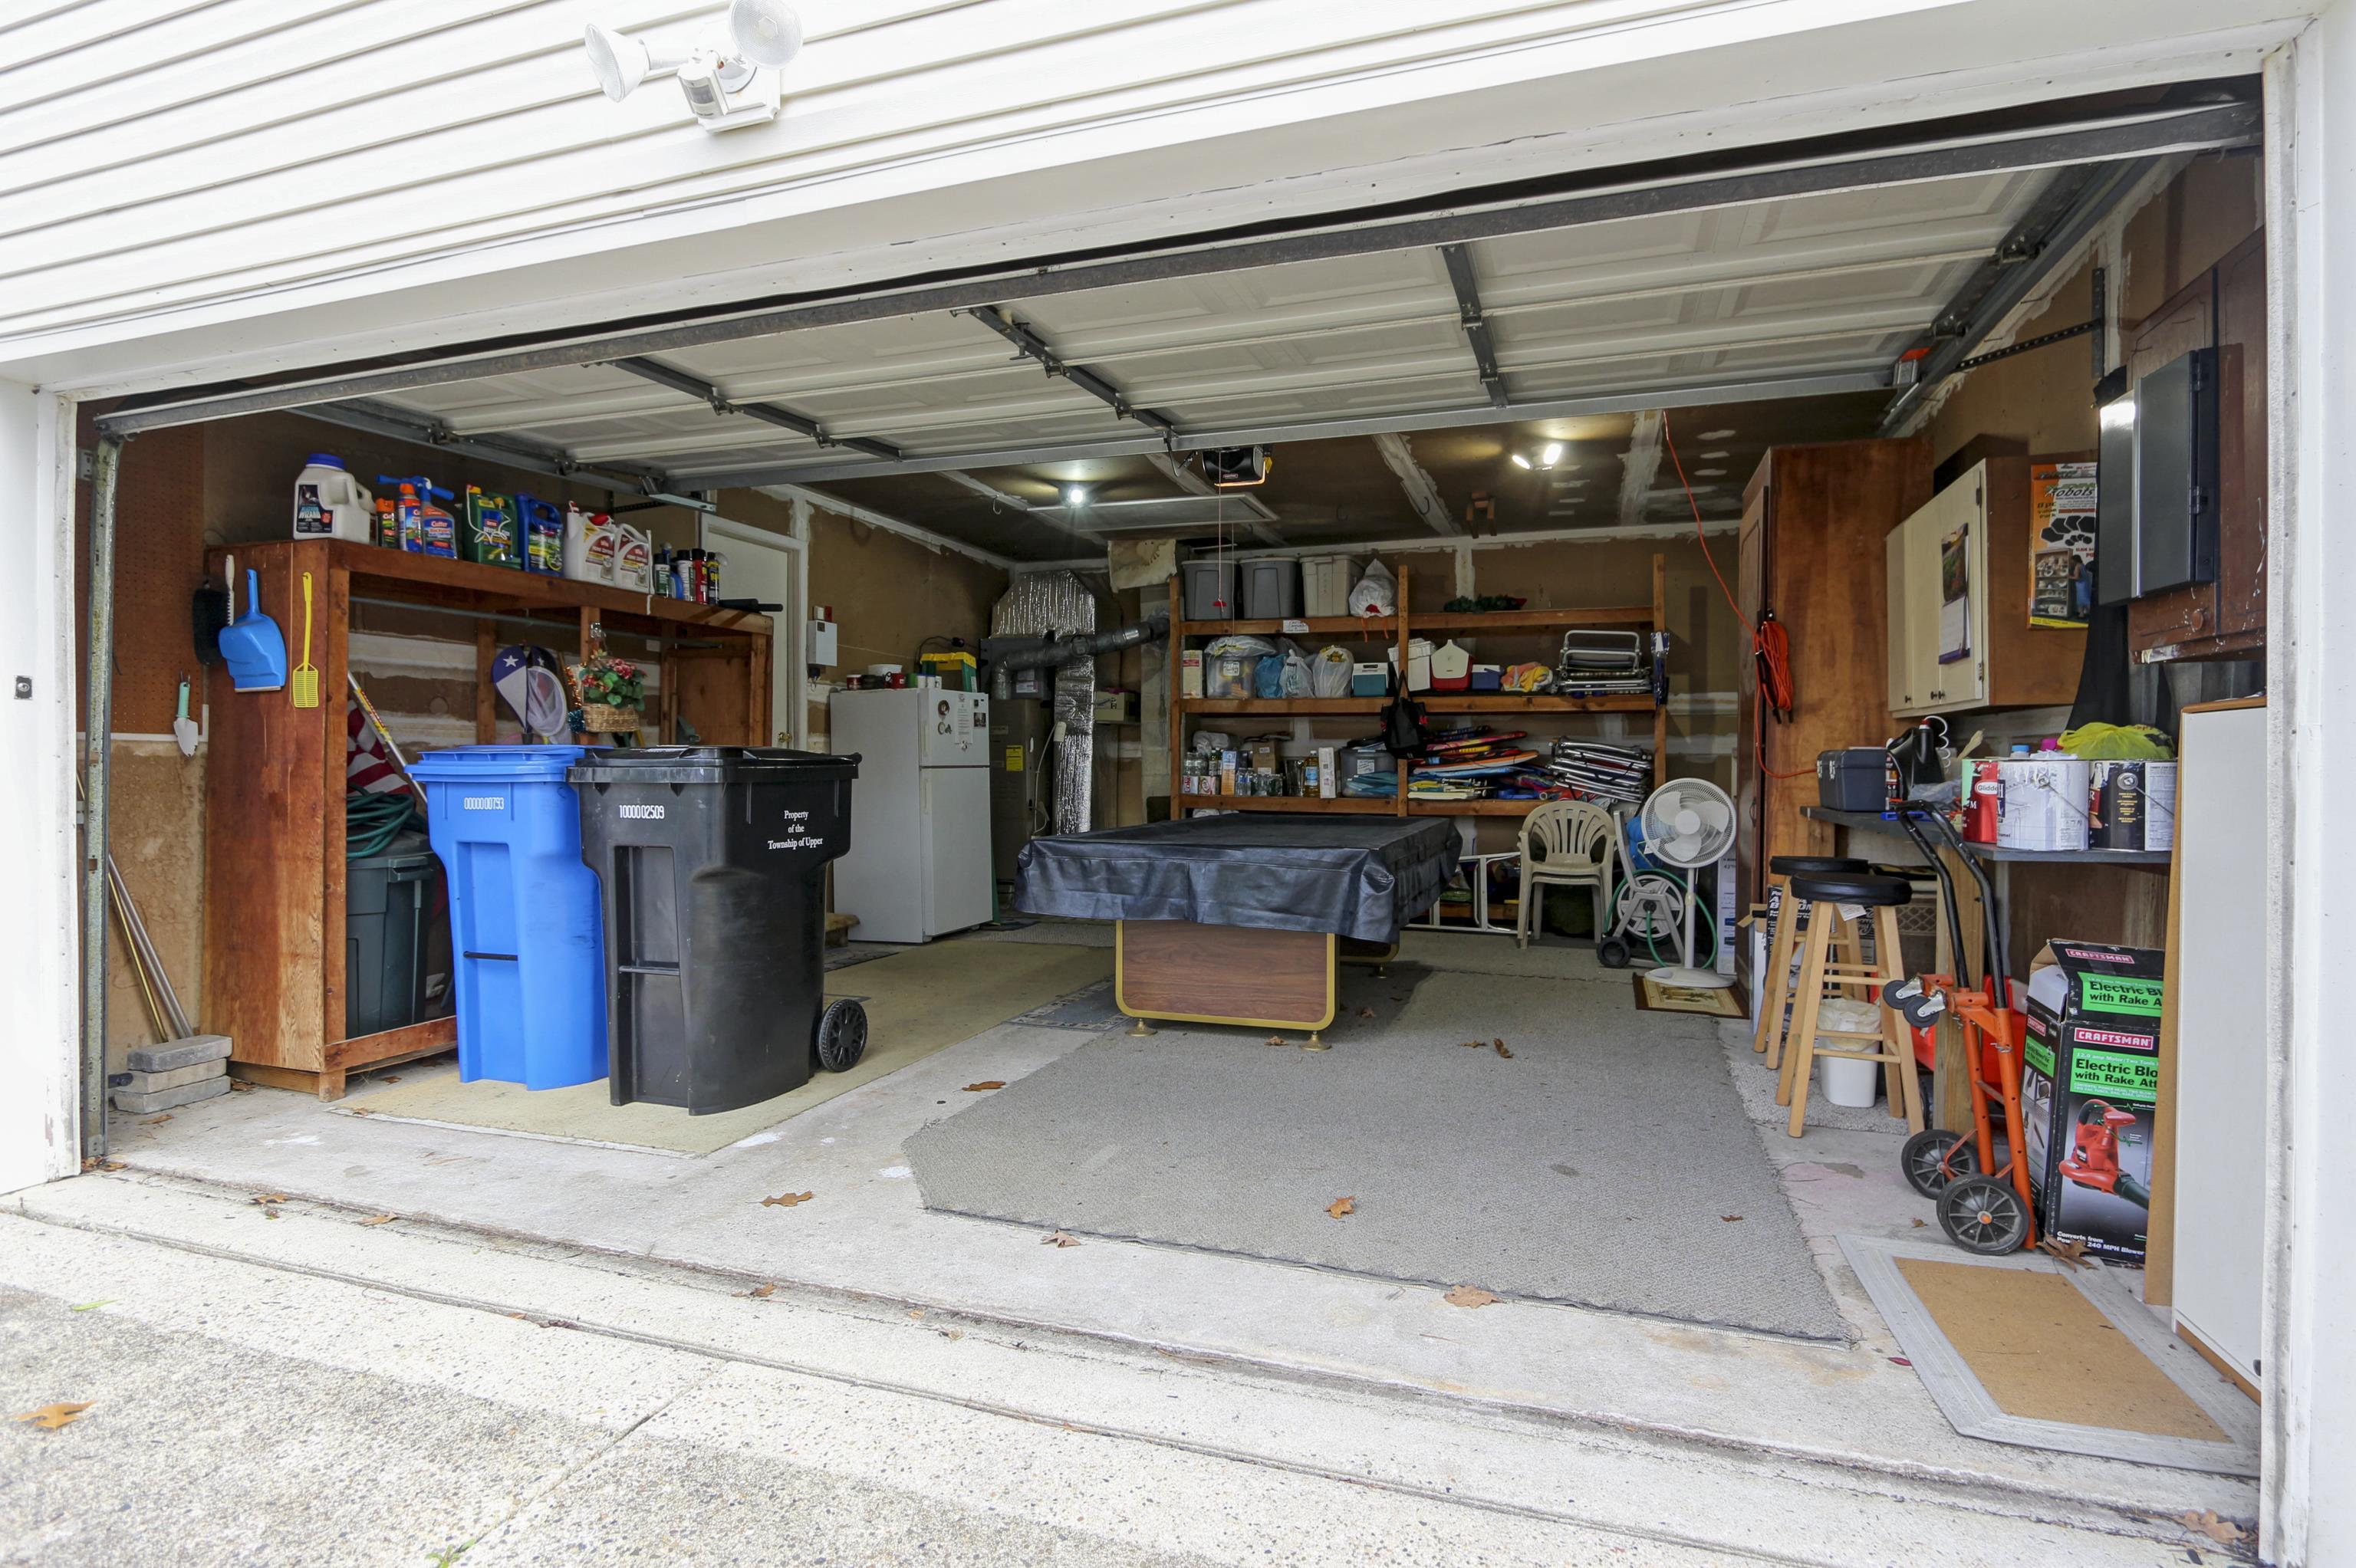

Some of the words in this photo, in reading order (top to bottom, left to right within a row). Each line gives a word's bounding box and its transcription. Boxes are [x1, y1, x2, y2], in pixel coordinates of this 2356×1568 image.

[784, 810, 809, 821] Property
[788, 824, 795, 833] of
[795, 823, 805, 833] the
[768, 839, 798, 850] Township
[798, 837, 805, 846] of
[805, 837, 823, 848] Upper
[2069, 951, 2131, 962] CRAFTSMAN
[2090, 981, 2144, 994] Electric
[2090, 993, 2114, 1002] with
[2119, 994, 2149, 1005] Rake
[2078, 1031, 2150, 1046] CRAFTSMAN
[2076, 1058, 2131, 1075] Electric
[2075, 1071, 2100, 1081] with
[2104, 1074, 2134, 1085] Rake
[2057, 1231, 2086, 1241] Converts
[2103, 1244, 2120, 1252] MPH
[2121, 1247, 2145, 1255] Blower
